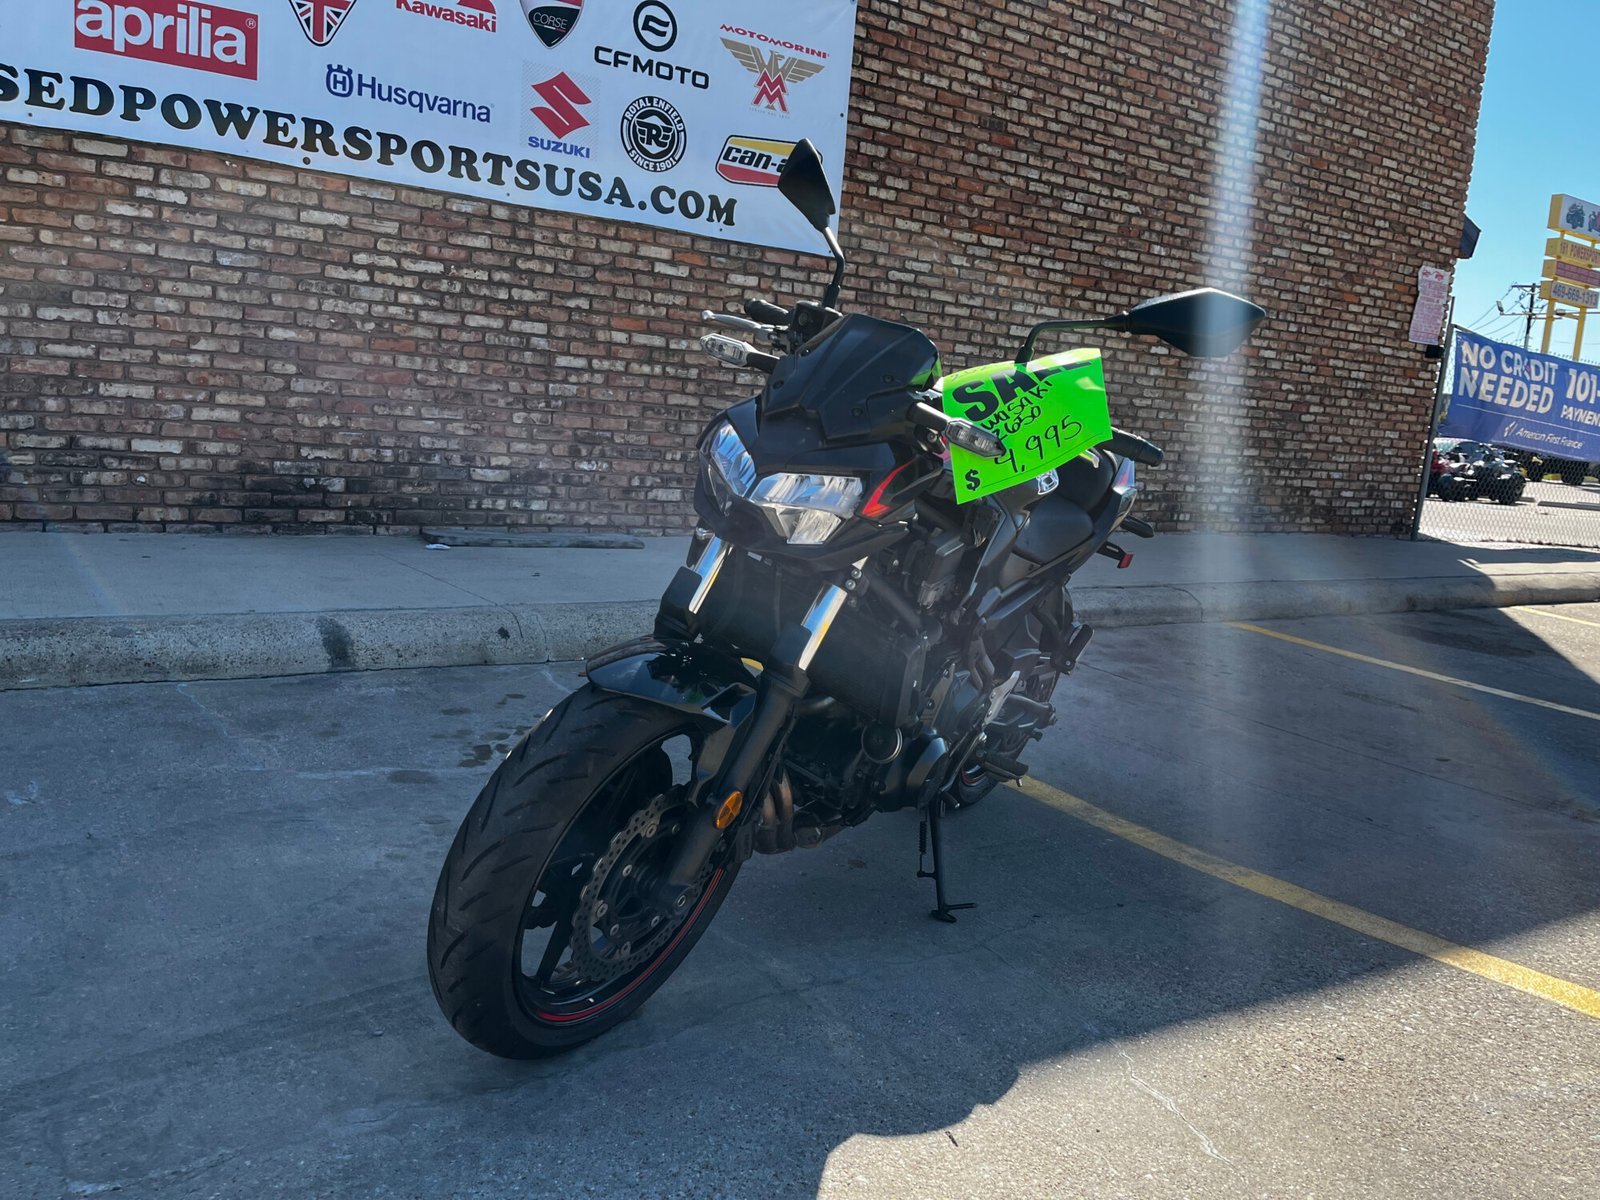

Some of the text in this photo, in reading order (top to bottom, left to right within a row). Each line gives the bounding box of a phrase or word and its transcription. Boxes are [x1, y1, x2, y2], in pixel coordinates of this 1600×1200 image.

[396, 0, 496, 33] Kawasaki
[532, 12, 568, 31] CORSE
[75, 0, 247, 67] aprilia
[594, 45, 710, 90] CFMOTO
[357, 74, 491, 123] Husqvarna
[624, 97, 684, 131] ROYAL ENFIELD
[528, 136, 591, 159] SUZUKI
[629, 150, 677, 171] SINCE 1901
[722, 146, 788, 173] can-a
[1461, 341, 1496, 370] NO
[1458, 367, 1554, 414] NEEDED
